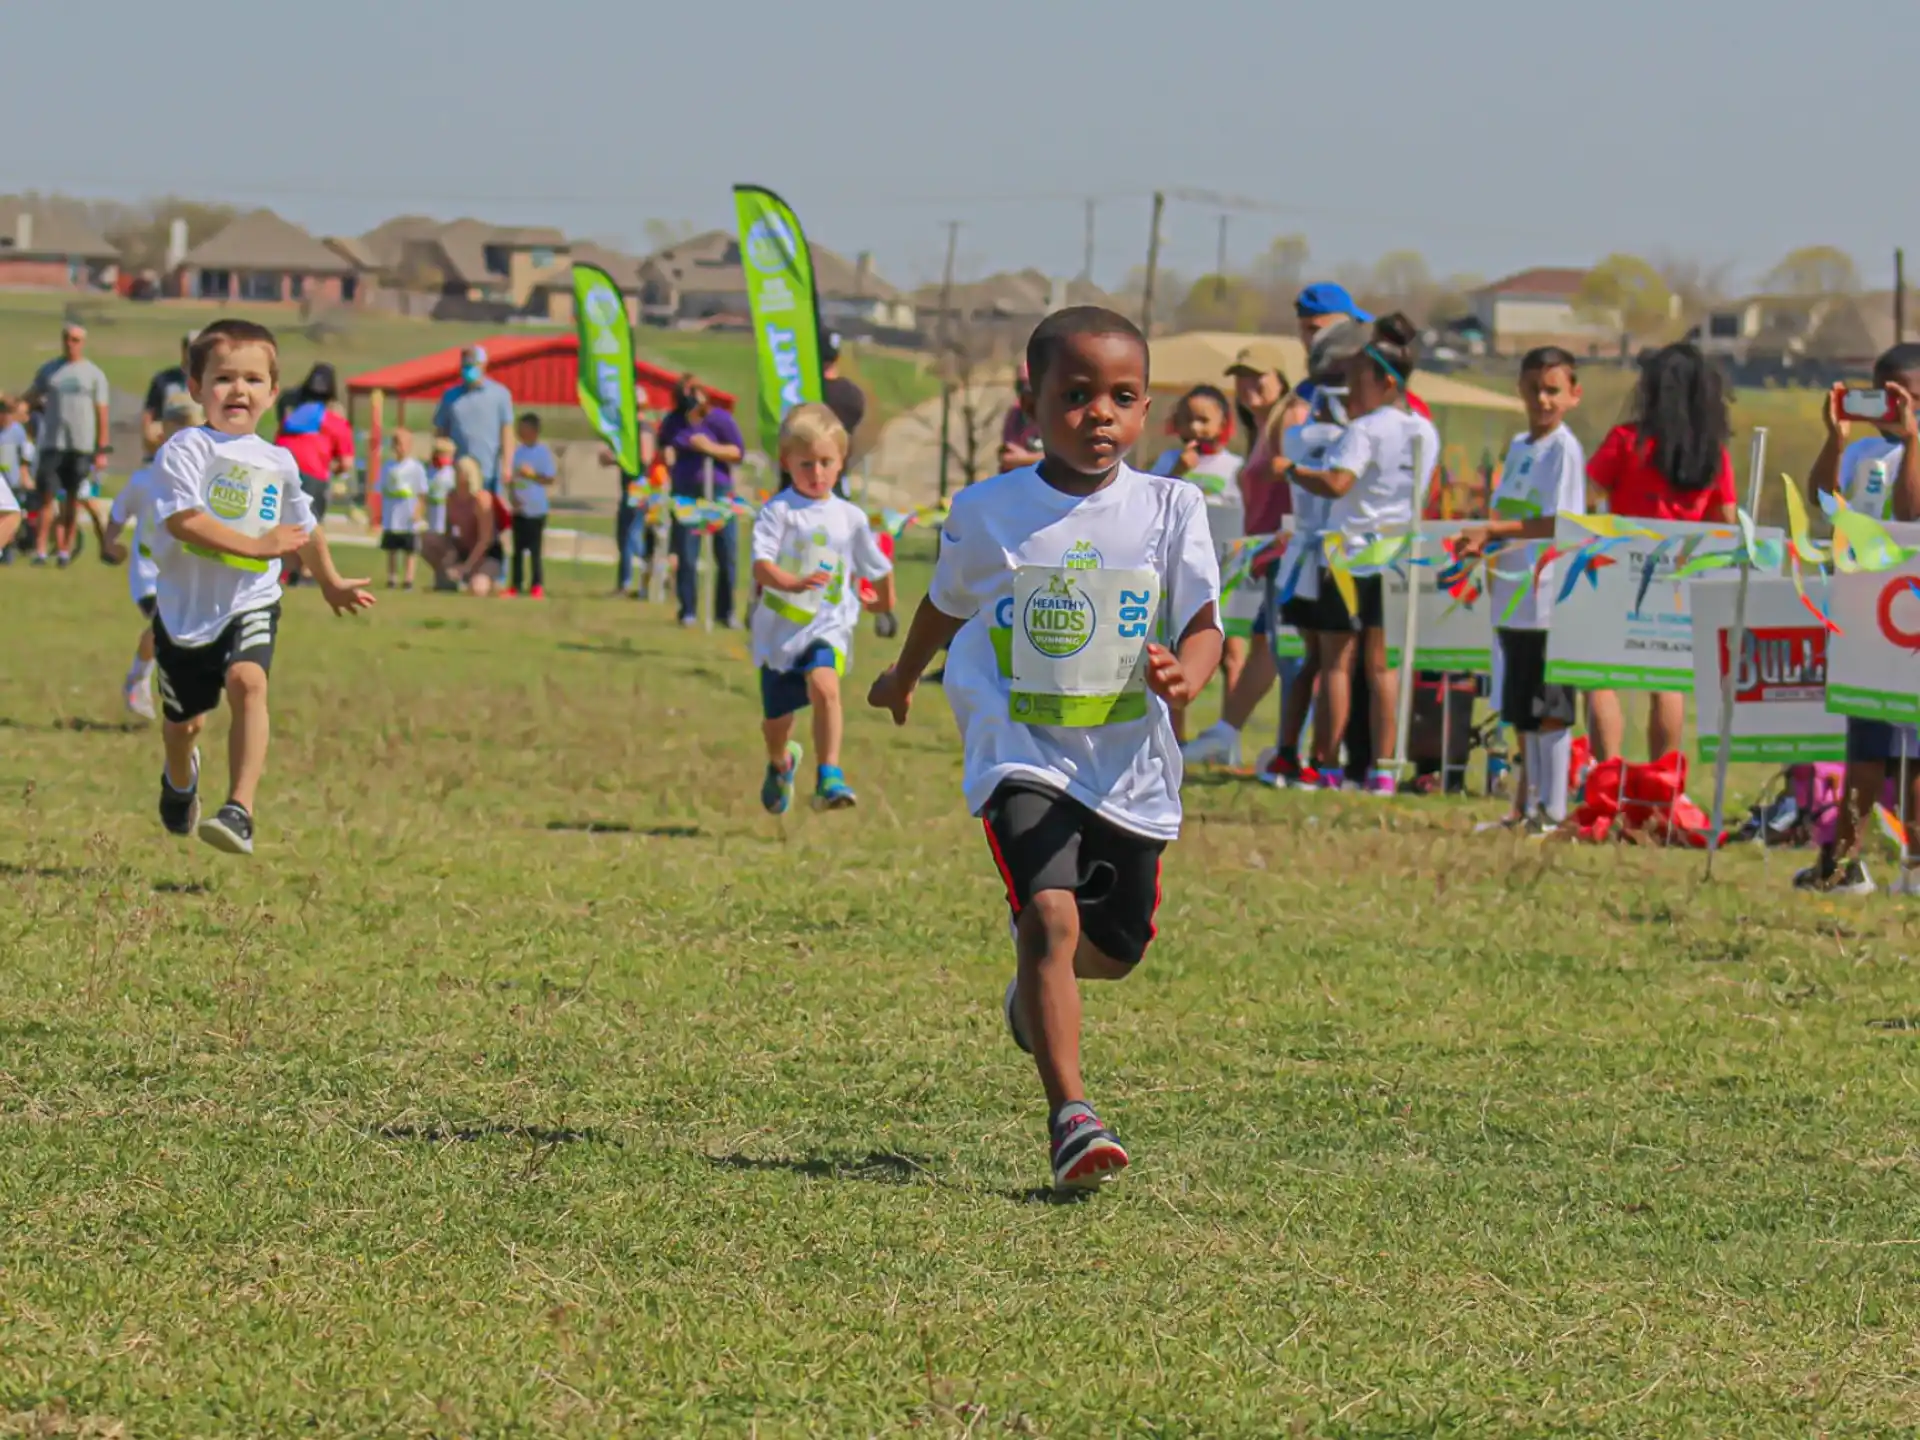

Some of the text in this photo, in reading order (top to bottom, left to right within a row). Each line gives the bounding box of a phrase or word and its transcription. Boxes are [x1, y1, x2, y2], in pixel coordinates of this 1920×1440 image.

[766, 322, 804, 408] ART
[1032, 609, 1085, 631] KIDS
[1033, 597, 1086, 610] HEALTHY
[1118, 590, 1149, 638] 265
